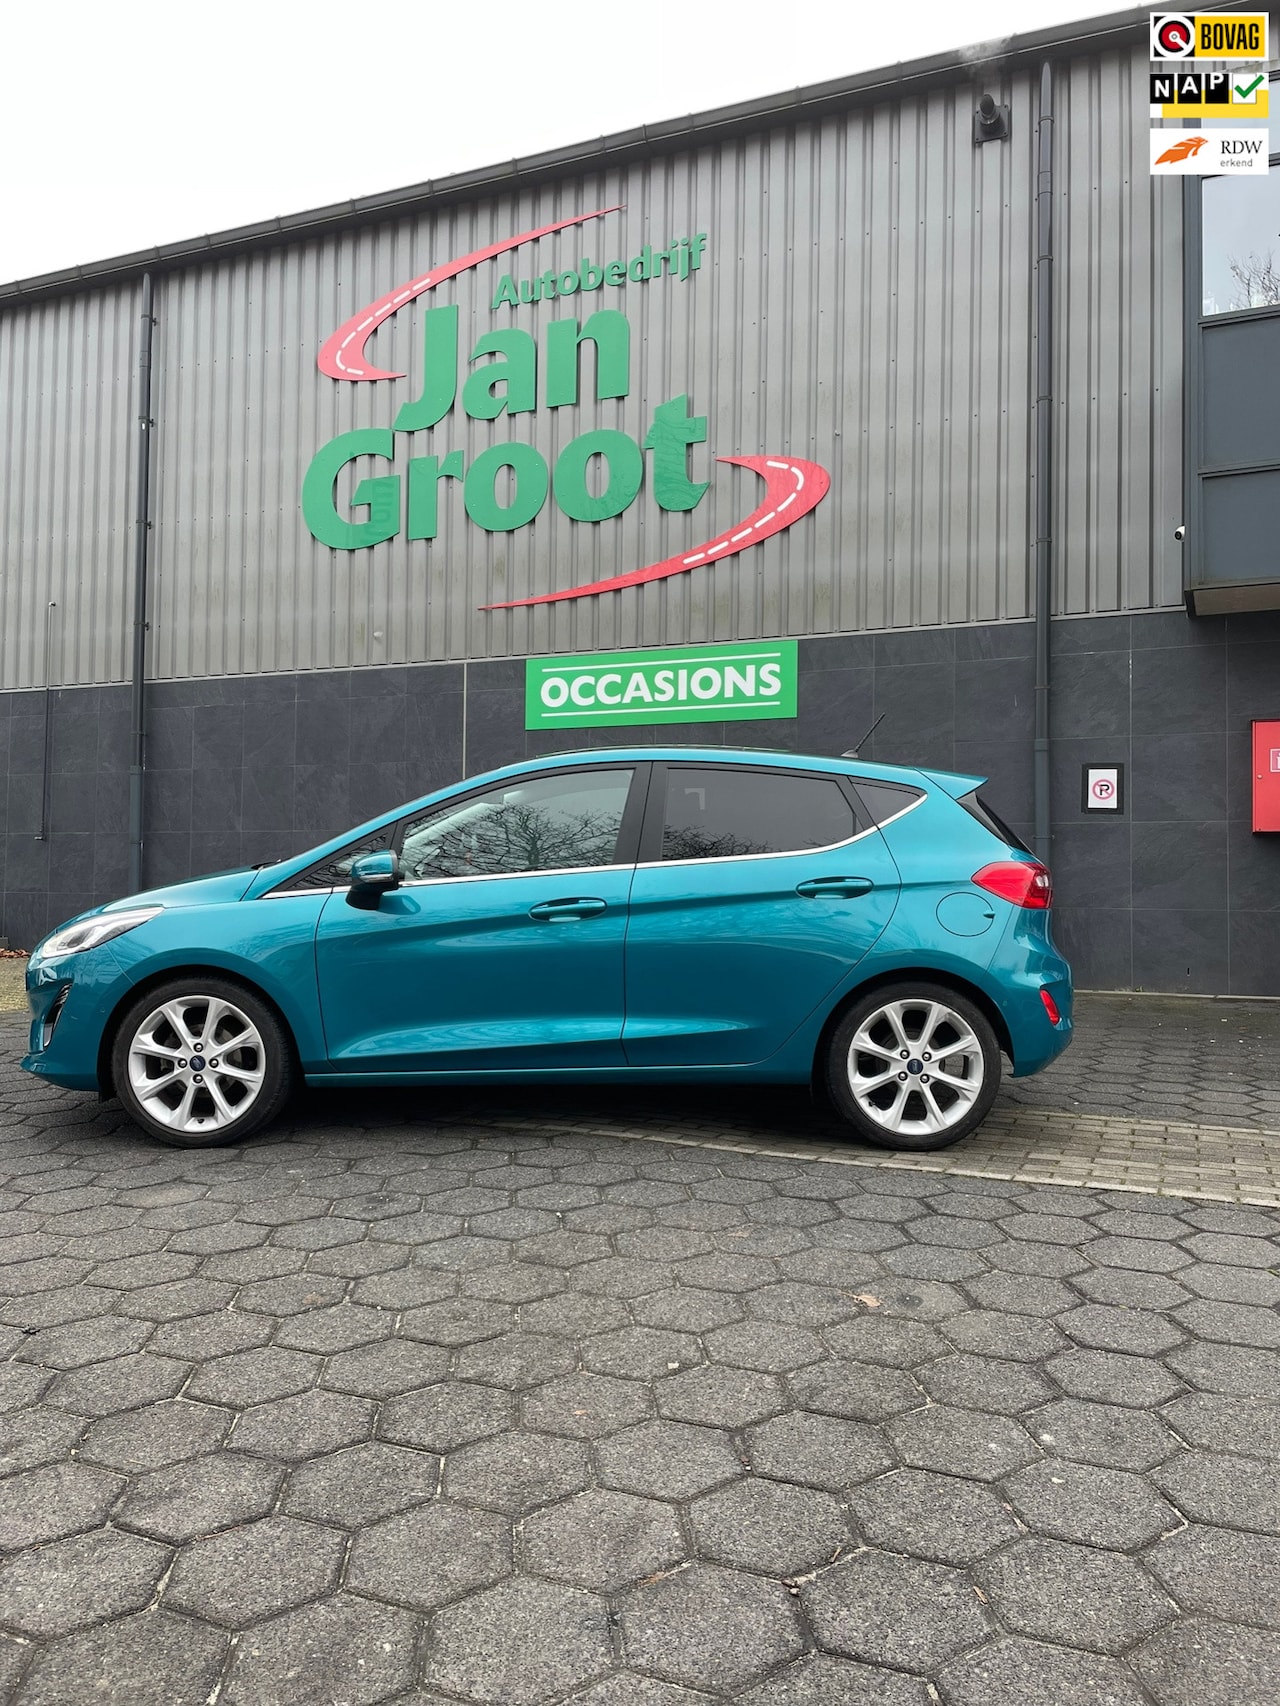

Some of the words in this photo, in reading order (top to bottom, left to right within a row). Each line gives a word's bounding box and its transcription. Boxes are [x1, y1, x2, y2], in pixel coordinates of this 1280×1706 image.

[491, 233, 708, 310] Autobedrijf
[393, 304, 631, 432] Jan
[302, 393, 711, 550] Groot
[540, 663, 782, 708] OCCASIONS
